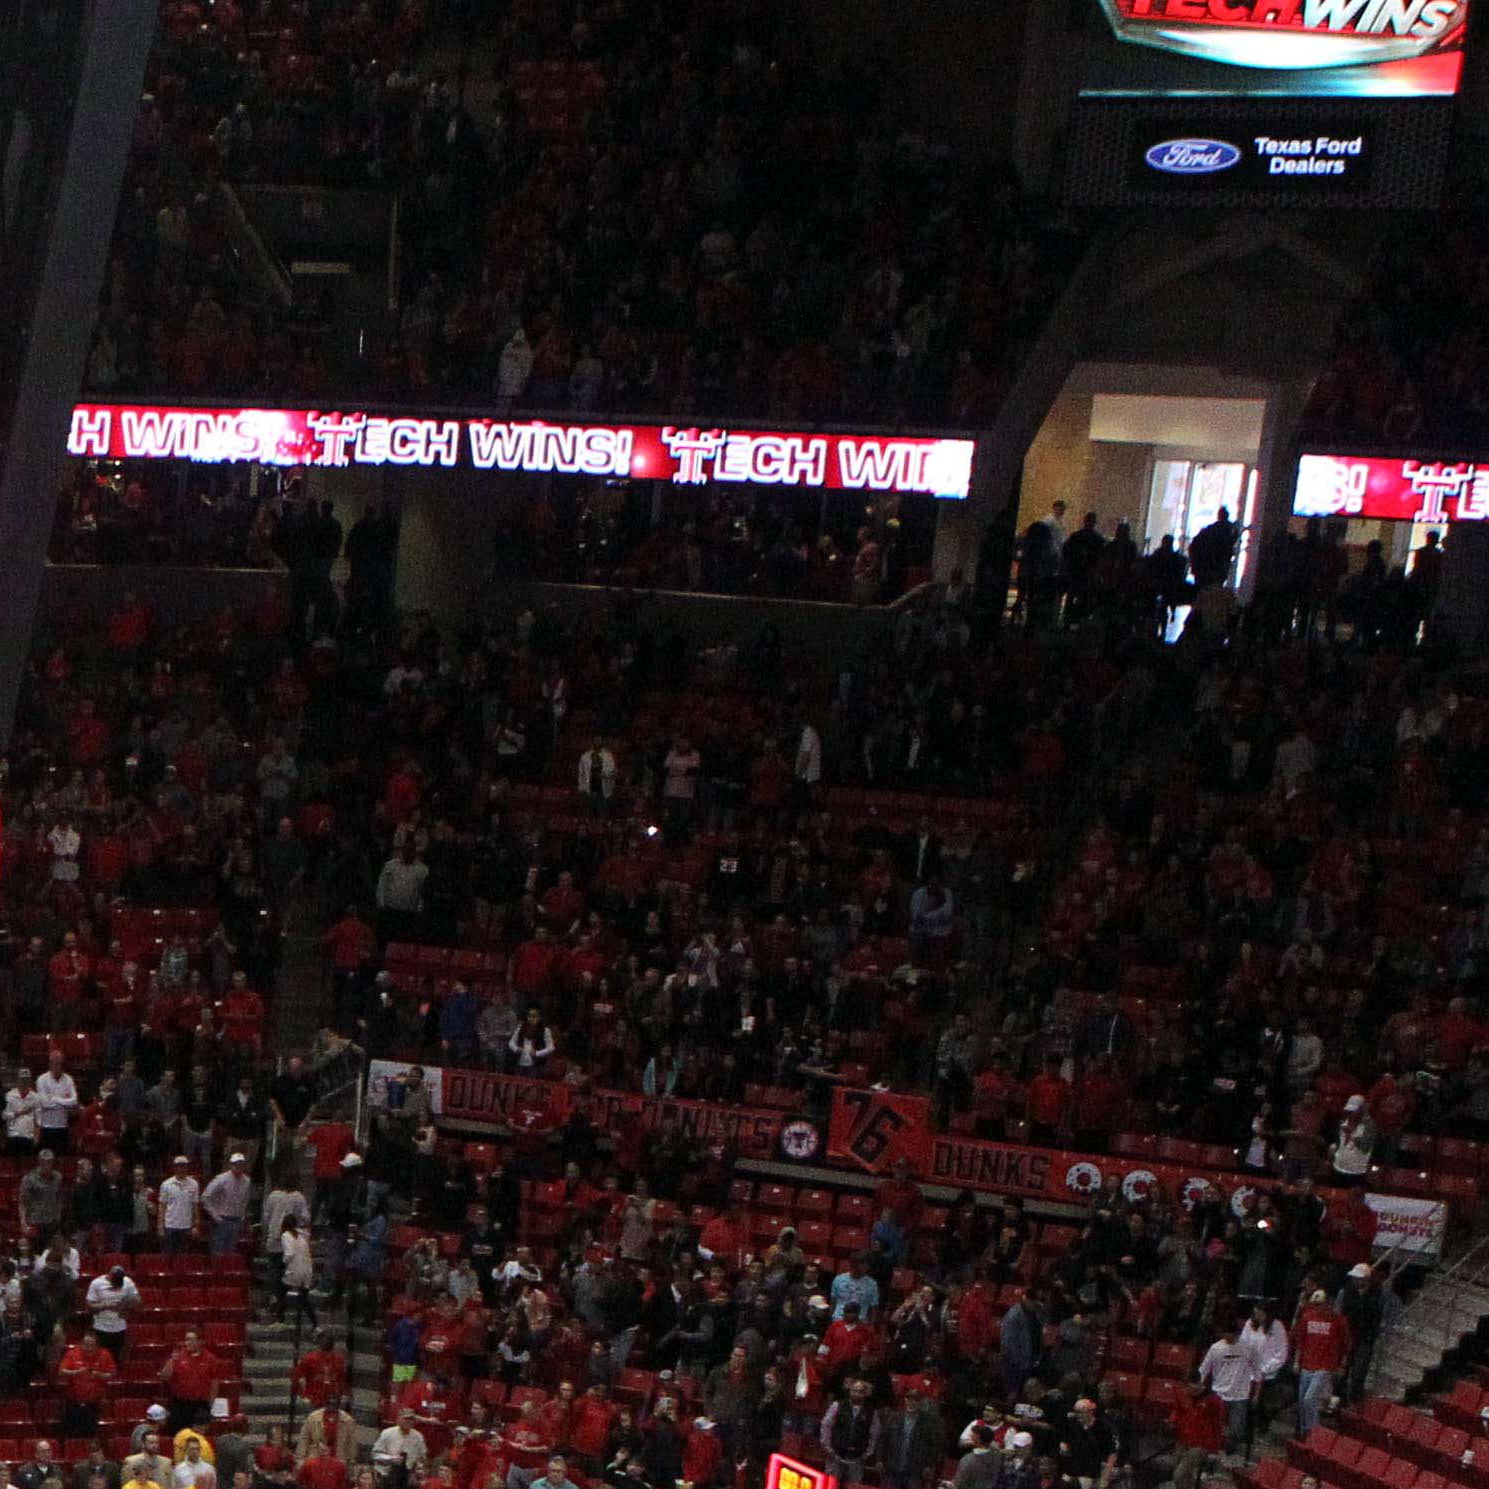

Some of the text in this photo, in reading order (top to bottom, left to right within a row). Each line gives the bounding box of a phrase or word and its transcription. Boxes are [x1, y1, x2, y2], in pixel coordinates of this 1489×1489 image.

[1254, 136, 1362, 156] Texas Ford
[1269, 155, 1346, 175] Dealers
[308, 410, 633, 475] TECH WINS!
[662, 427, 826, 485] TECH
